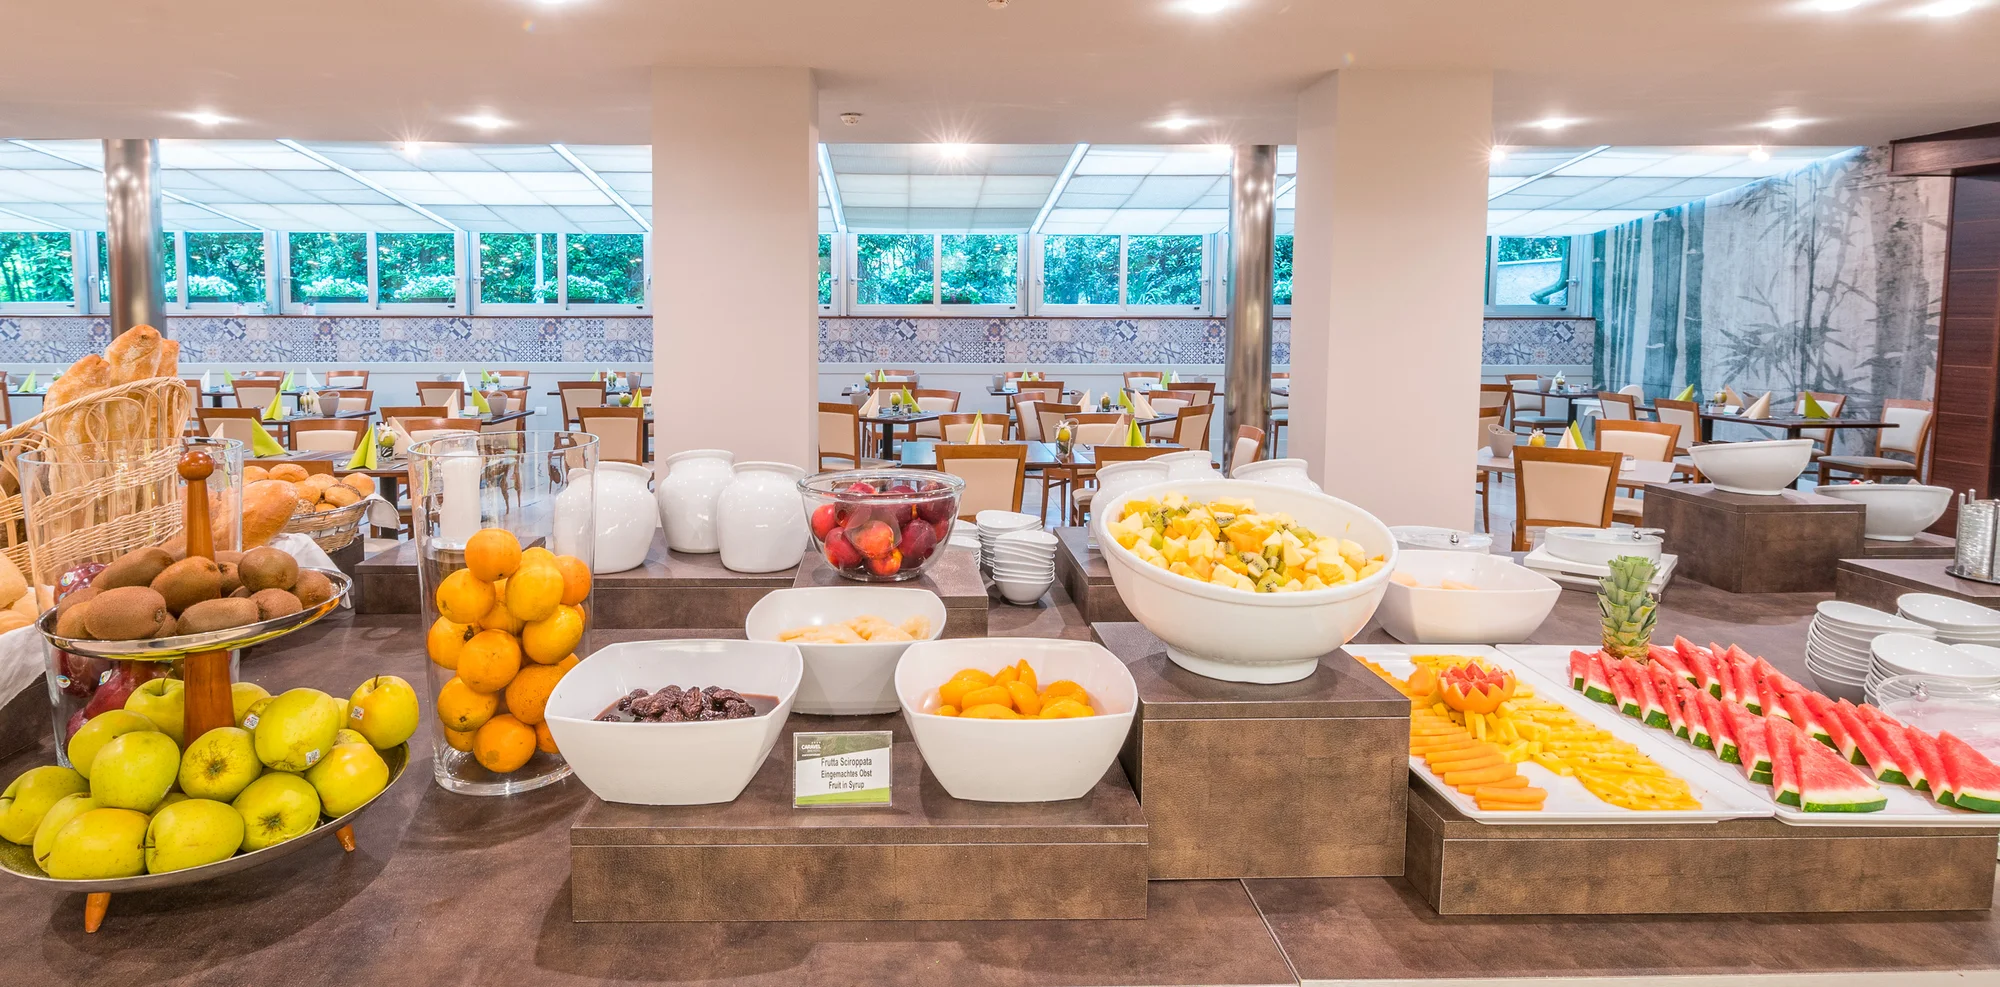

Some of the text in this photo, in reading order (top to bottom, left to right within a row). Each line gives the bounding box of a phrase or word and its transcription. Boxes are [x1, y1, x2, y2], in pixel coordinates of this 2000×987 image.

[821, 757, 872, 768] Frutta Sciroppata
[821, 769, 872, 780] Eingemachtes Obst
[828, 780, 864, 790] Fruit in Syrup
